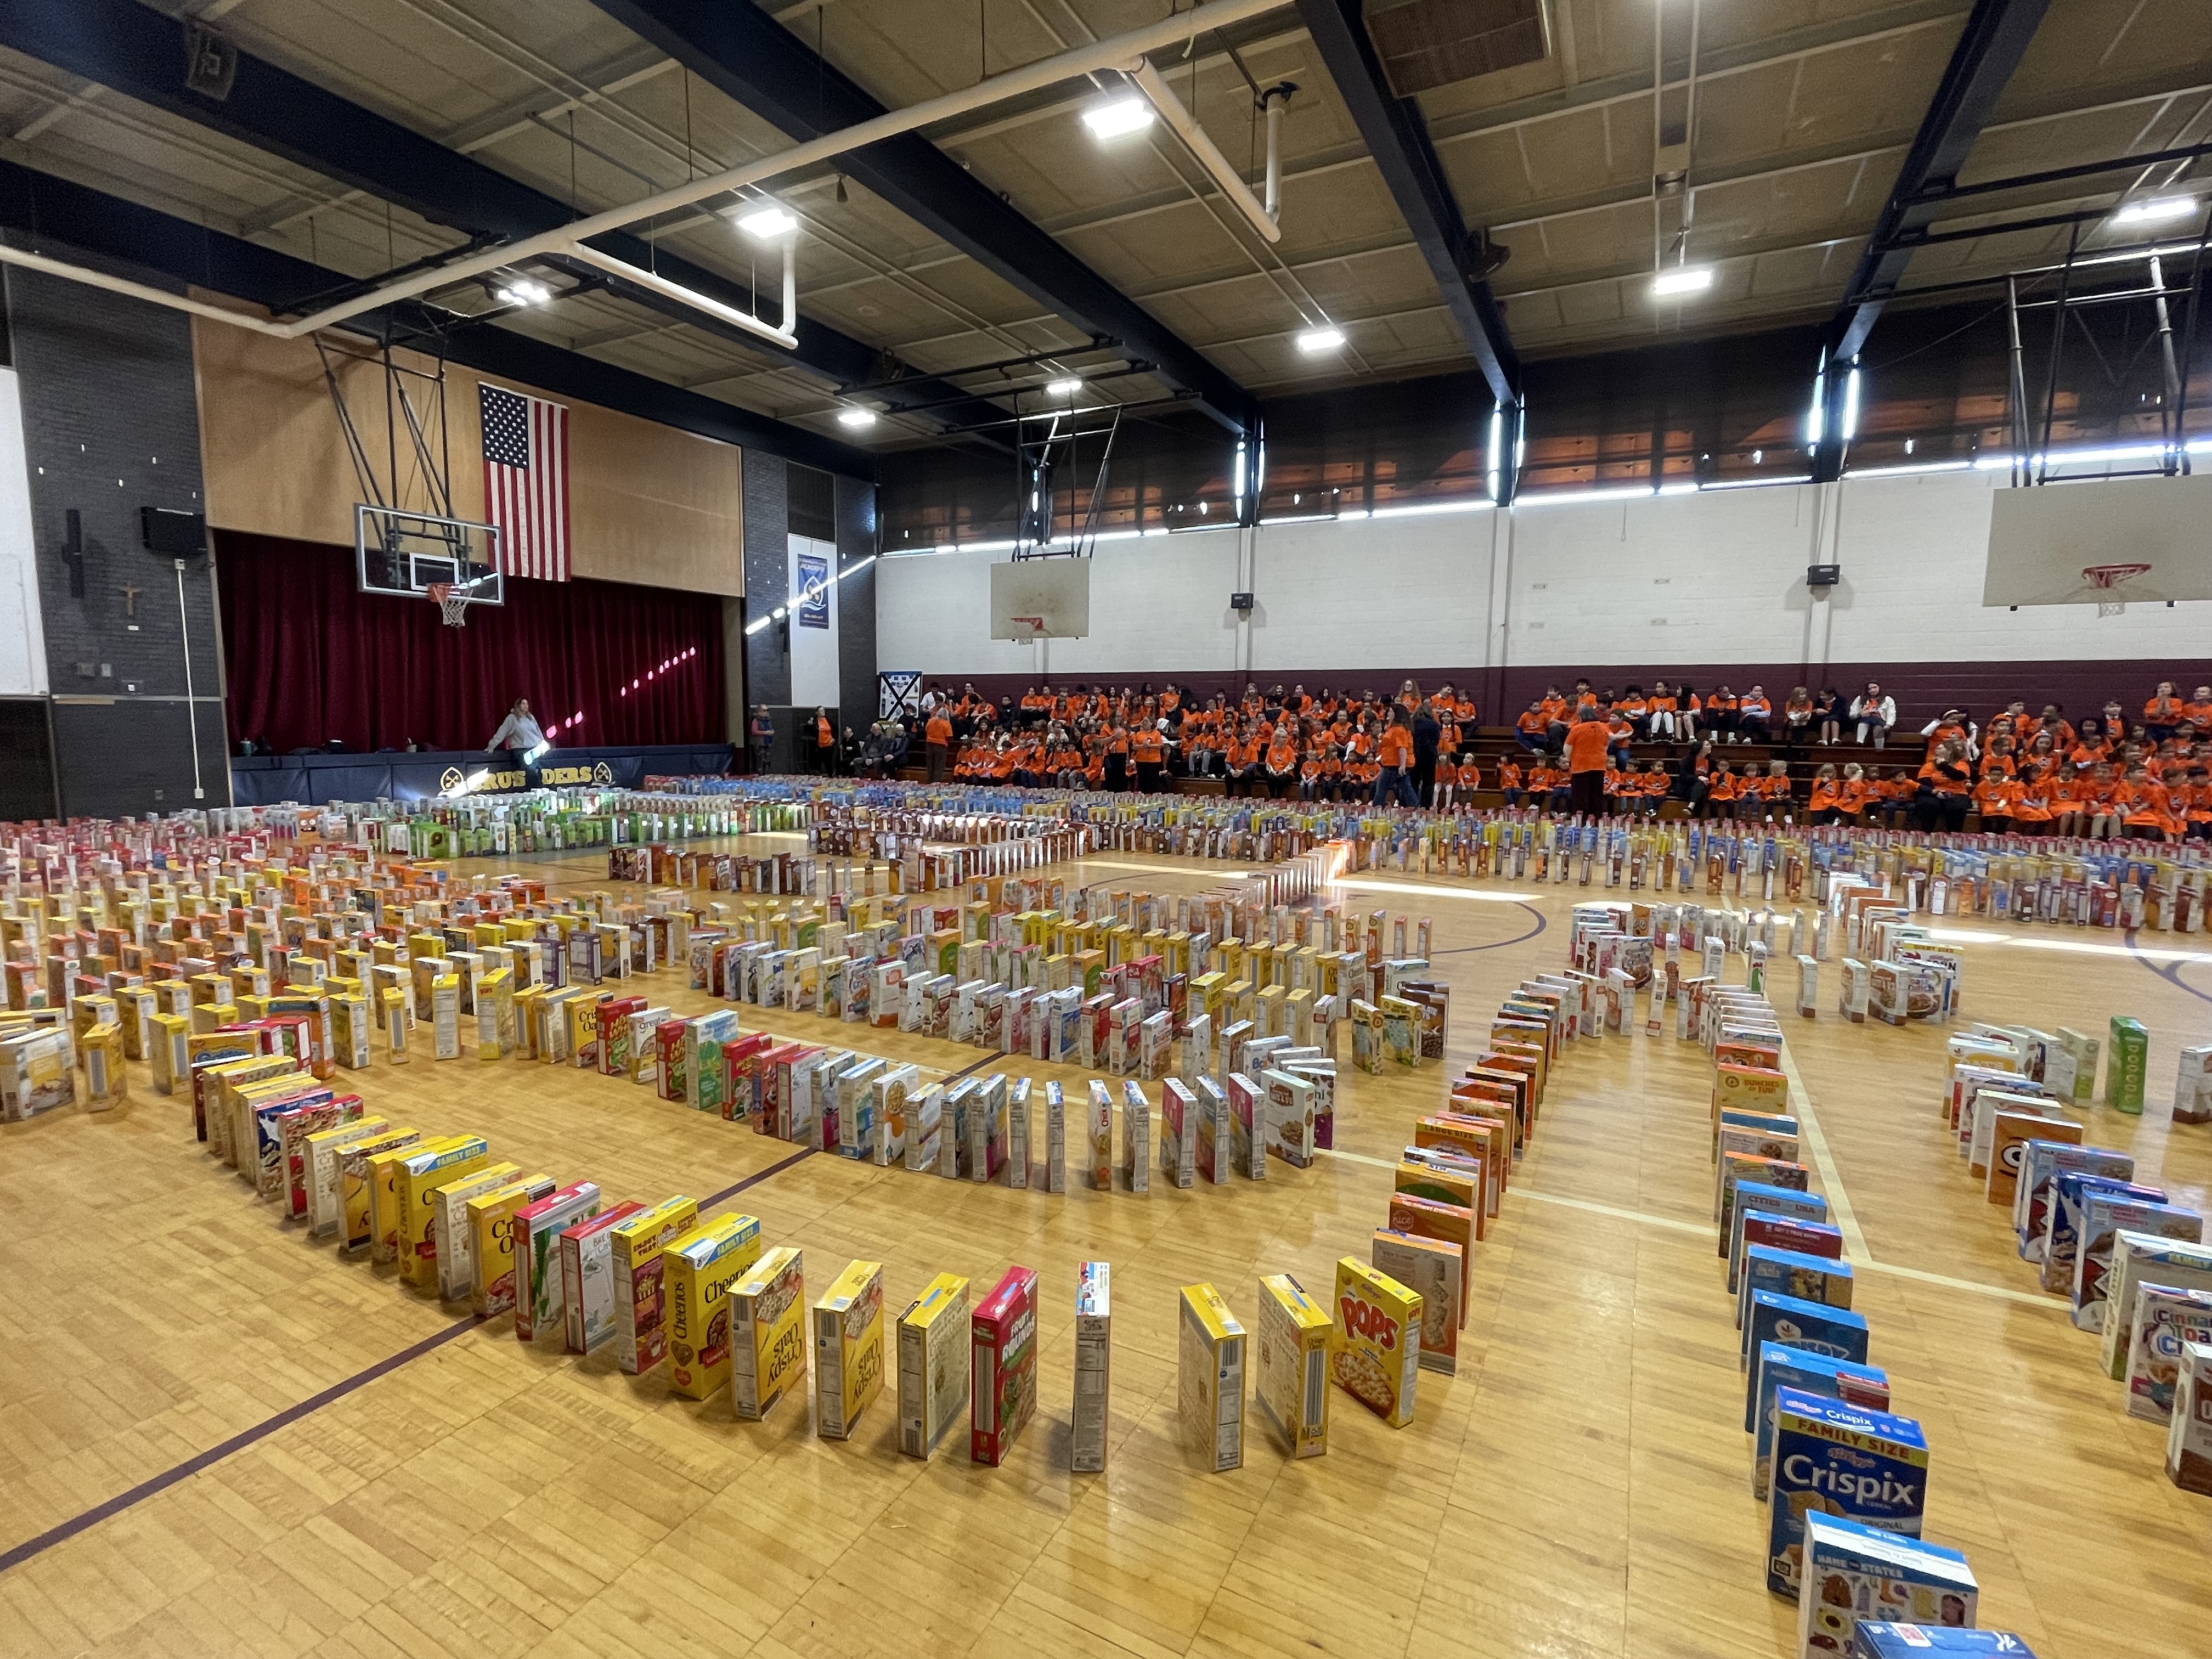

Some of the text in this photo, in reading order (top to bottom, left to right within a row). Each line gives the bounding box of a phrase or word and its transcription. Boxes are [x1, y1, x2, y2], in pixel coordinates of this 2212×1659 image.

[466, 767, 591, 791] RUSDERS
[579, 1008, 596, 1023] Cri
[583, 1021, 596, 1032] Oa
[639, 1017, 661, 1034] great
[1314, 1088, 1325, 1100] hi
[1425, 1124, 1474, 1139] LARGE SIZE
[1340, 1297, 1398, 1350] POPS
[2174, 1324, 2211, 1344] Toa
[773, 1322, 798, 1359] Oats
[767, 1338, 802, 1387] Crispy
[858, 1338, 878, 1374] Oats
[854, 1353, 881, 1404] Crispy
[1826, 1409, 1872, 1426] Crispix
[1797, 1418, 1910, 1460] FAMILY SIZE
[1783, 1454, 1915, 1506] Crispix
[1859, 1518, 1904, 1530] ORIGINAL
